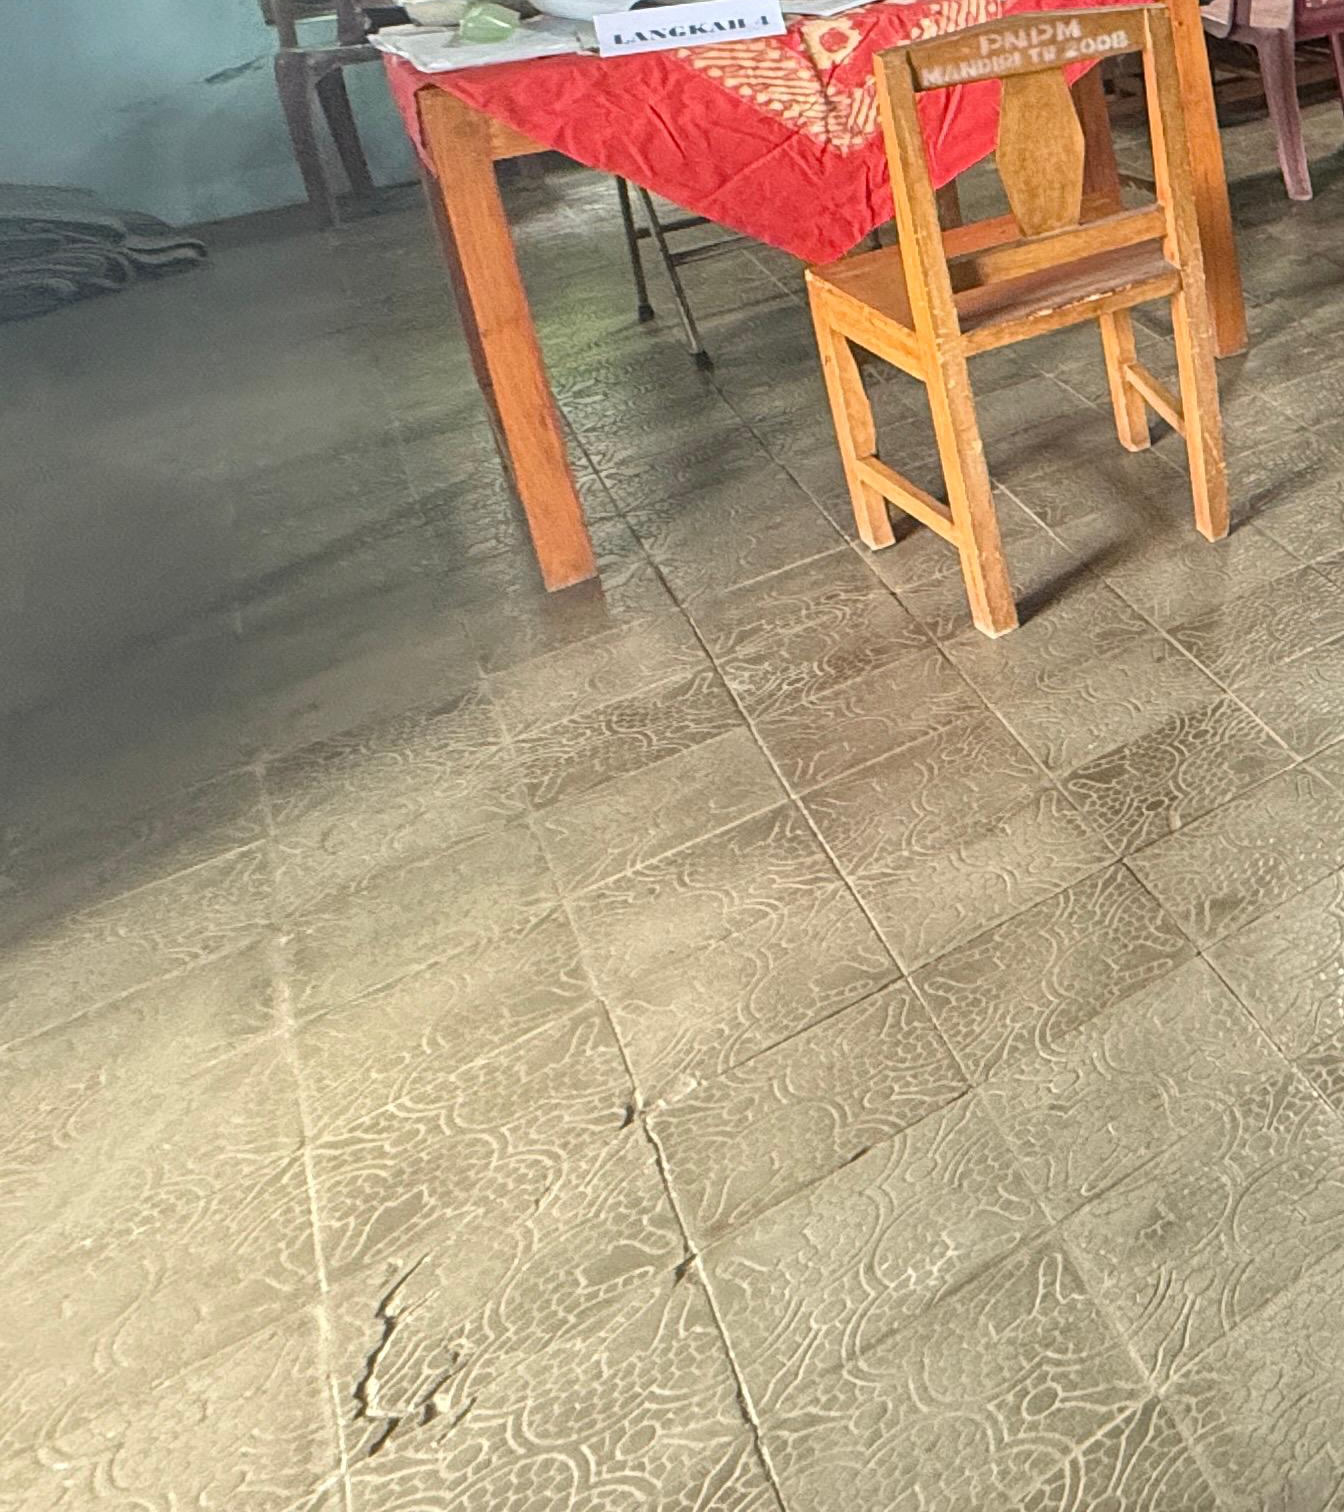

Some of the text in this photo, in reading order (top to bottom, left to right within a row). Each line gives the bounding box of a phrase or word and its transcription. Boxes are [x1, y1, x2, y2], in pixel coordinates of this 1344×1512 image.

[614, 17, 746, 45] LANGKAH
[979, 18, 1083, 56] PNPM
[920, 50, 1022, 87] MANDIRI
[1064, 29, 1129, 58] 2008
